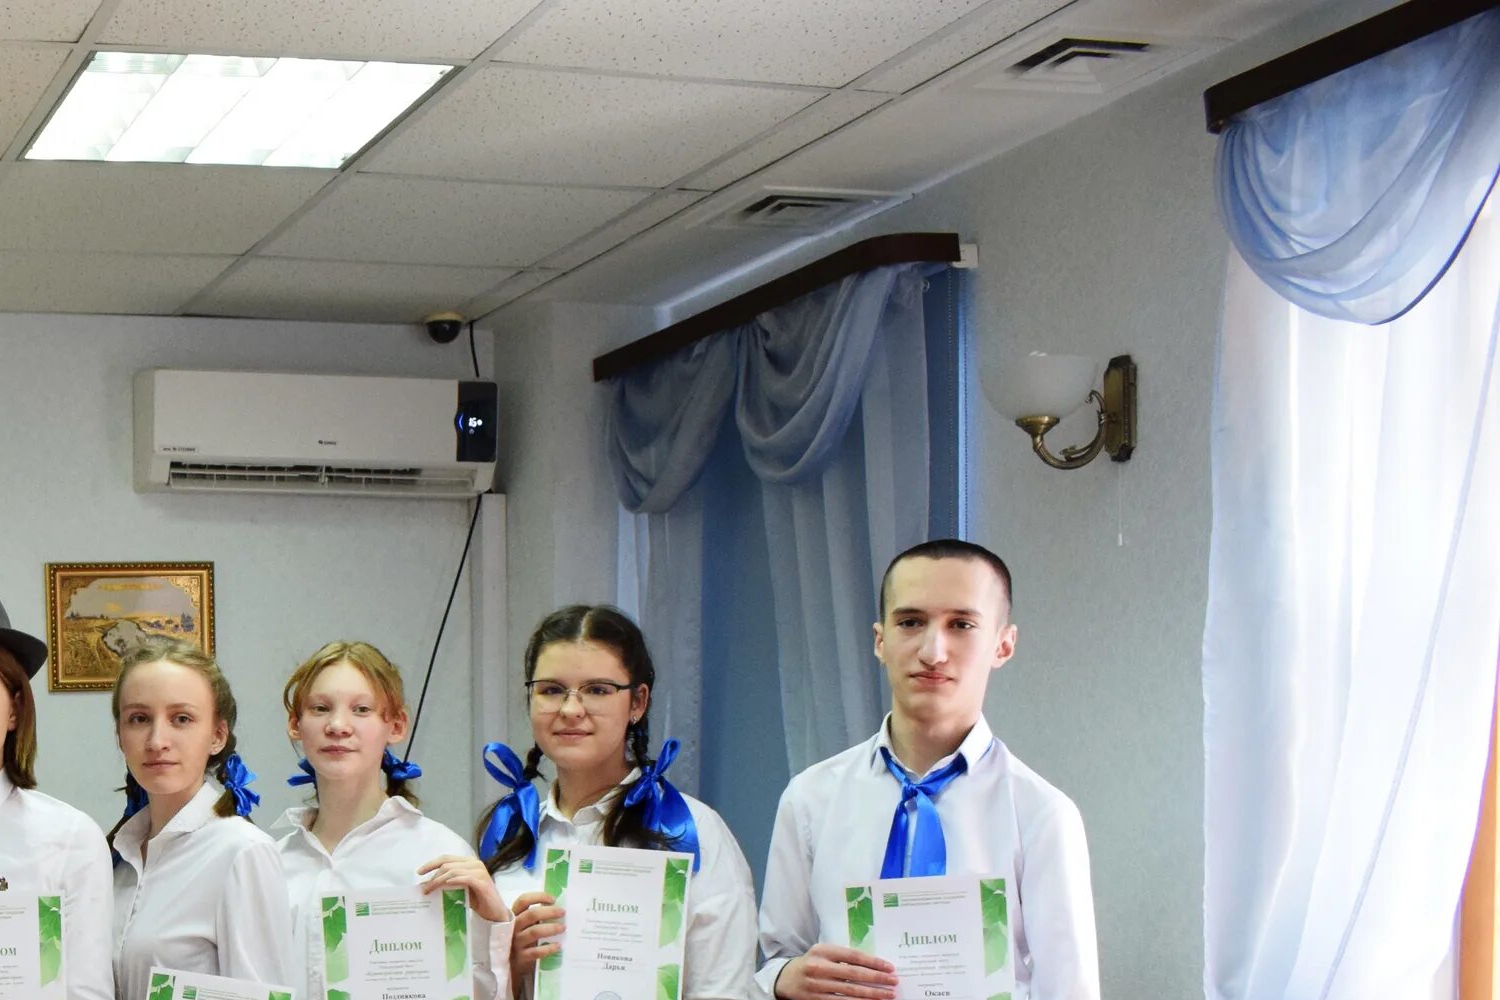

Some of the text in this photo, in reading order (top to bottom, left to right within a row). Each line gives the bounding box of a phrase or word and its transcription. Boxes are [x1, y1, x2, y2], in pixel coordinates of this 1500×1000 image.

[586, 898, 640, 914] Диплом
[369, 939, 423, 954] Диплом
[898, 931, 958, 948] Диплом
